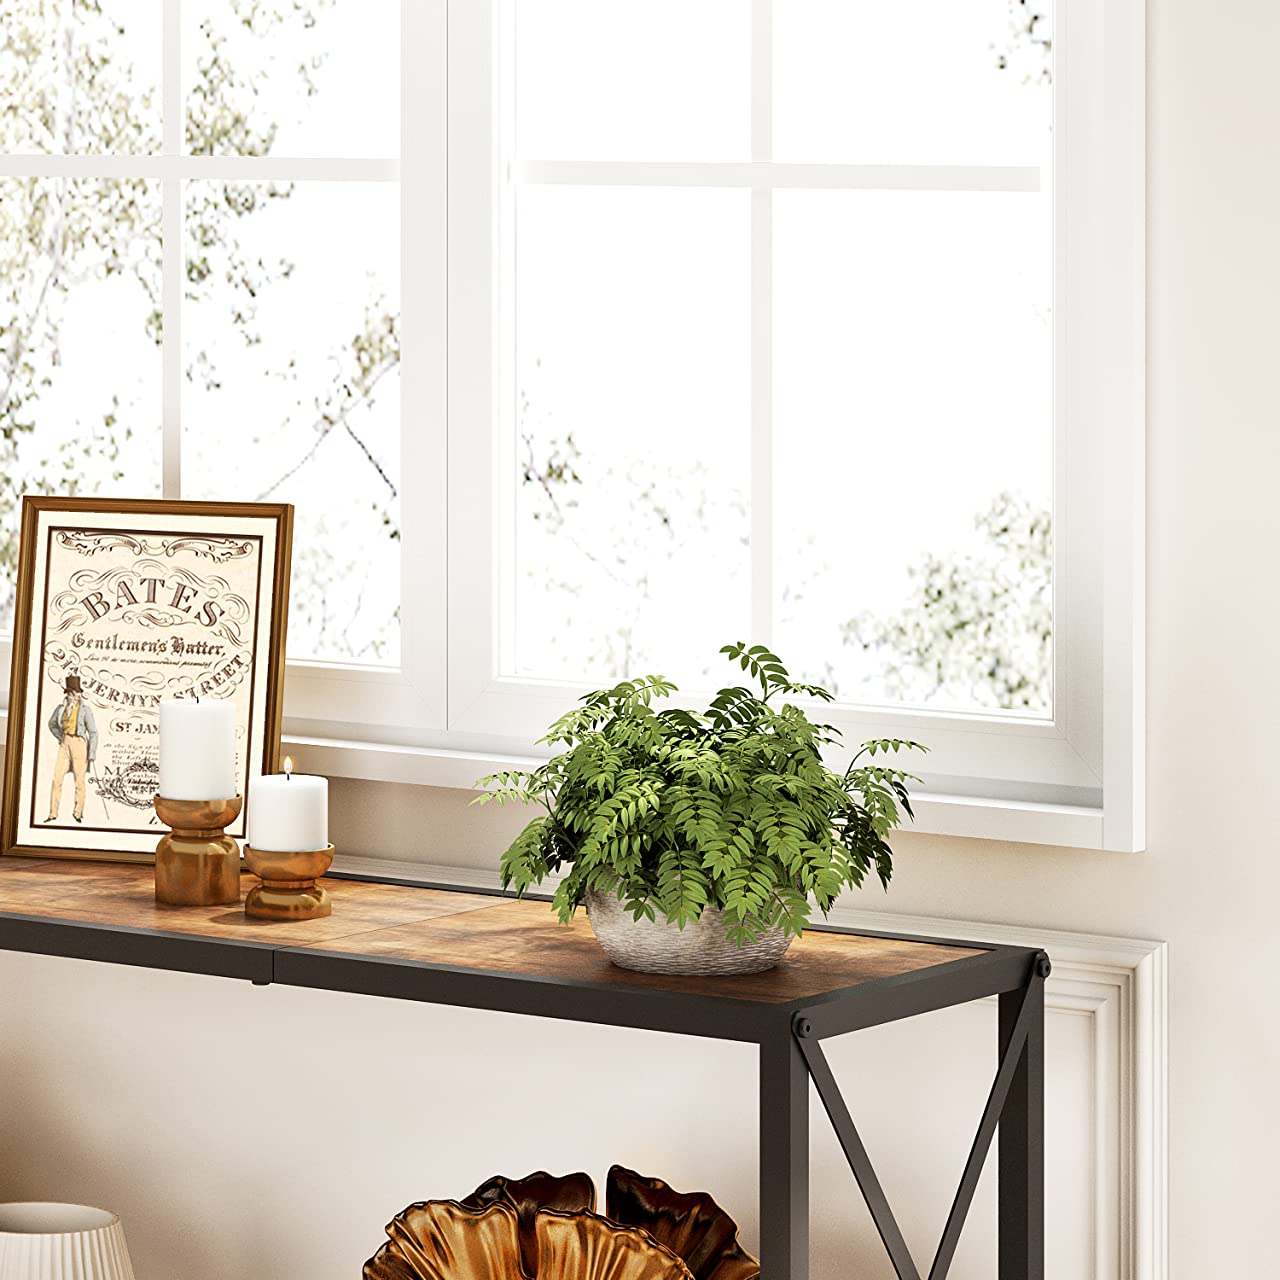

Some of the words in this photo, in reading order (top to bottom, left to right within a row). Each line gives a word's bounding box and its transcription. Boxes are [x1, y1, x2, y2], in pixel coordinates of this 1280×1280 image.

[79, 577, 226, 627] BATES
[71, 632, 167, 655] Gentlemen's
[82, 678, 162, 708] JERMYN
[173, 654, 245, 701] STREET
